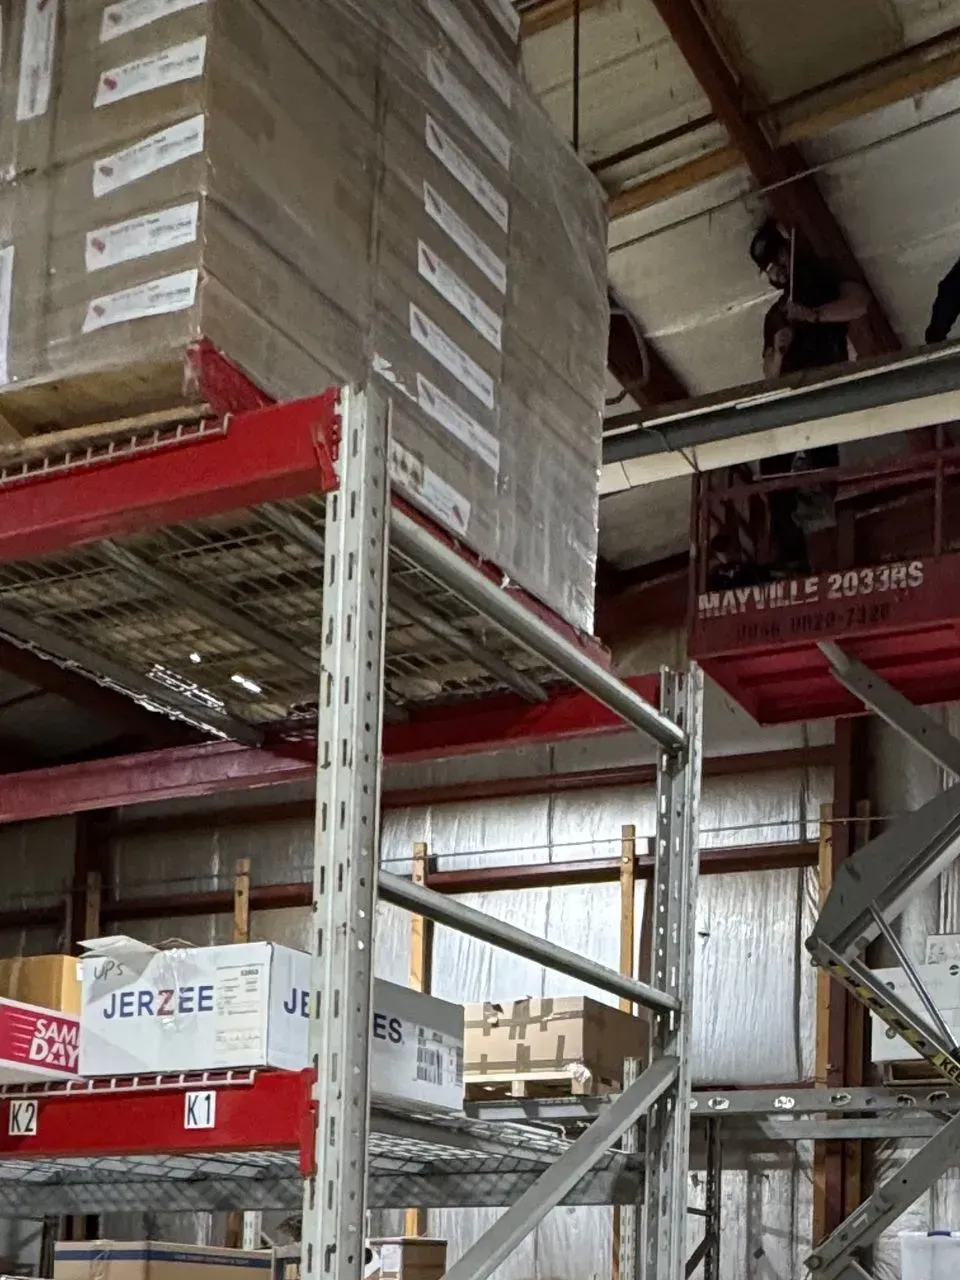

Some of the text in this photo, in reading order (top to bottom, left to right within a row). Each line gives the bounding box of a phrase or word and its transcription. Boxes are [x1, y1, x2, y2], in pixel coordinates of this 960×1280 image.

[698, 576, 820, 619] MAYVILLE
[103, 985, 214, 1019] JERZEE
[11, 1102, 36, 1132] K2
[187, 1093, 211, 1126] K1
